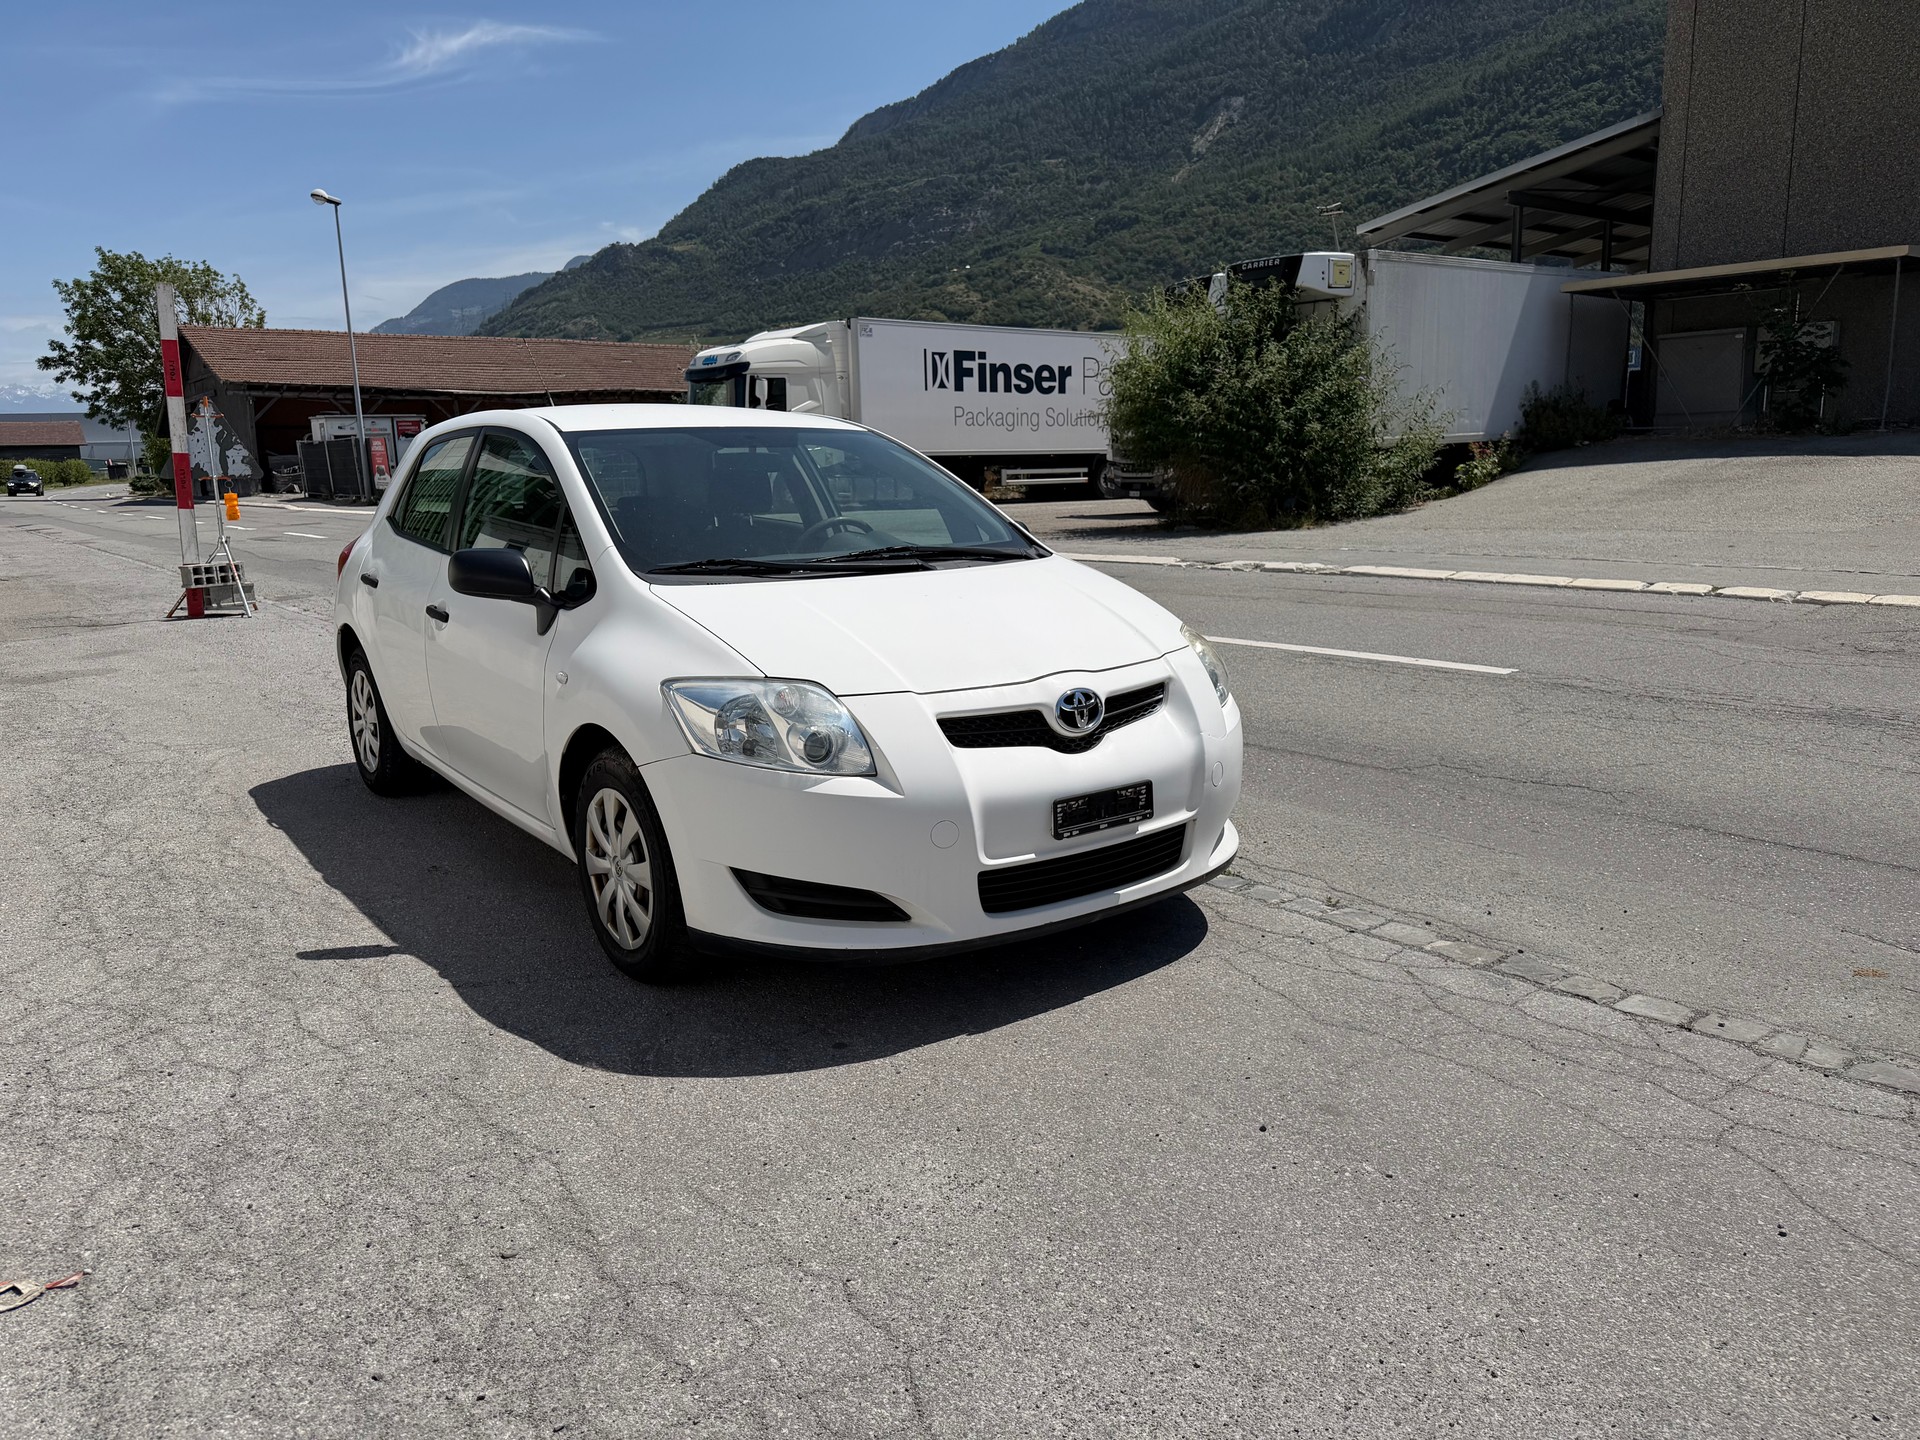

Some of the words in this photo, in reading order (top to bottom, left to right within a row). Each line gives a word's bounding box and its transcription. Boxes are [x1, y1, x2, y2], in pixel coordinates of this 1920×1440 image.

[1241, 258, 1281, 270] CARRIER
[953, 349, 1073, 395] Finser
[1083, 356, 1117, 396] Pa
[954, 406, 1040, 432] Packaging
